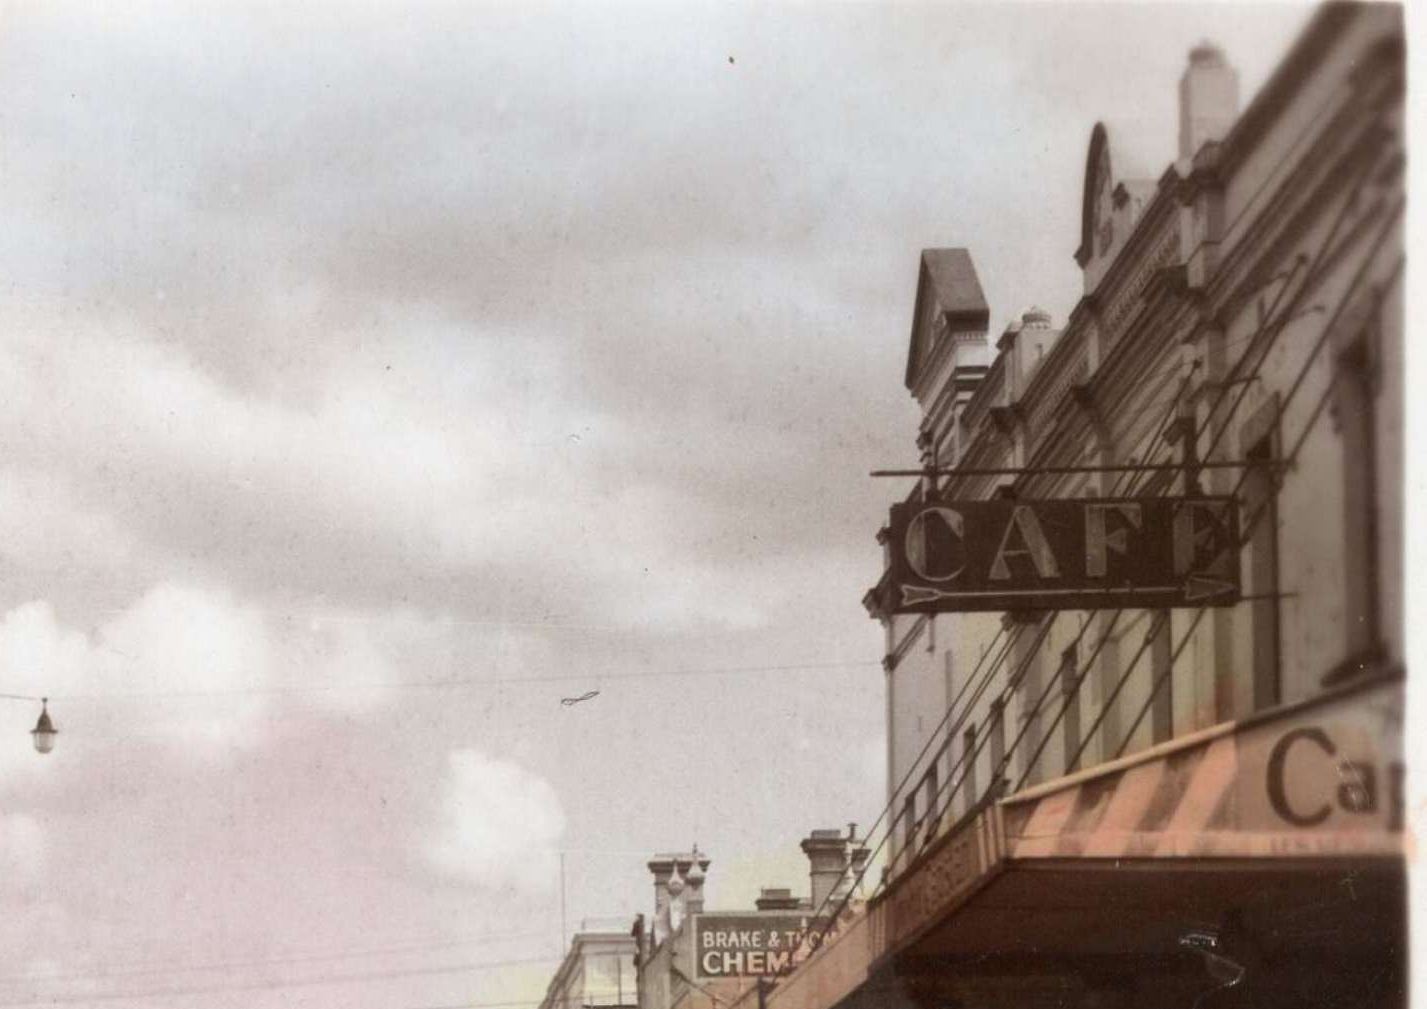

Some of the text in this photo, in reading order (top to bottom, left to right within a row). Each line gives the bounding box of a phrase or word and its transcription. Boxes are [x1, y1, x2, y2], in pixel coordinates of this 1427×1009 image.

[905, 502, 1230, 582] CAFE
[702, 930, 762, 949] BRAKE
[767, 930, 781, 948] &
